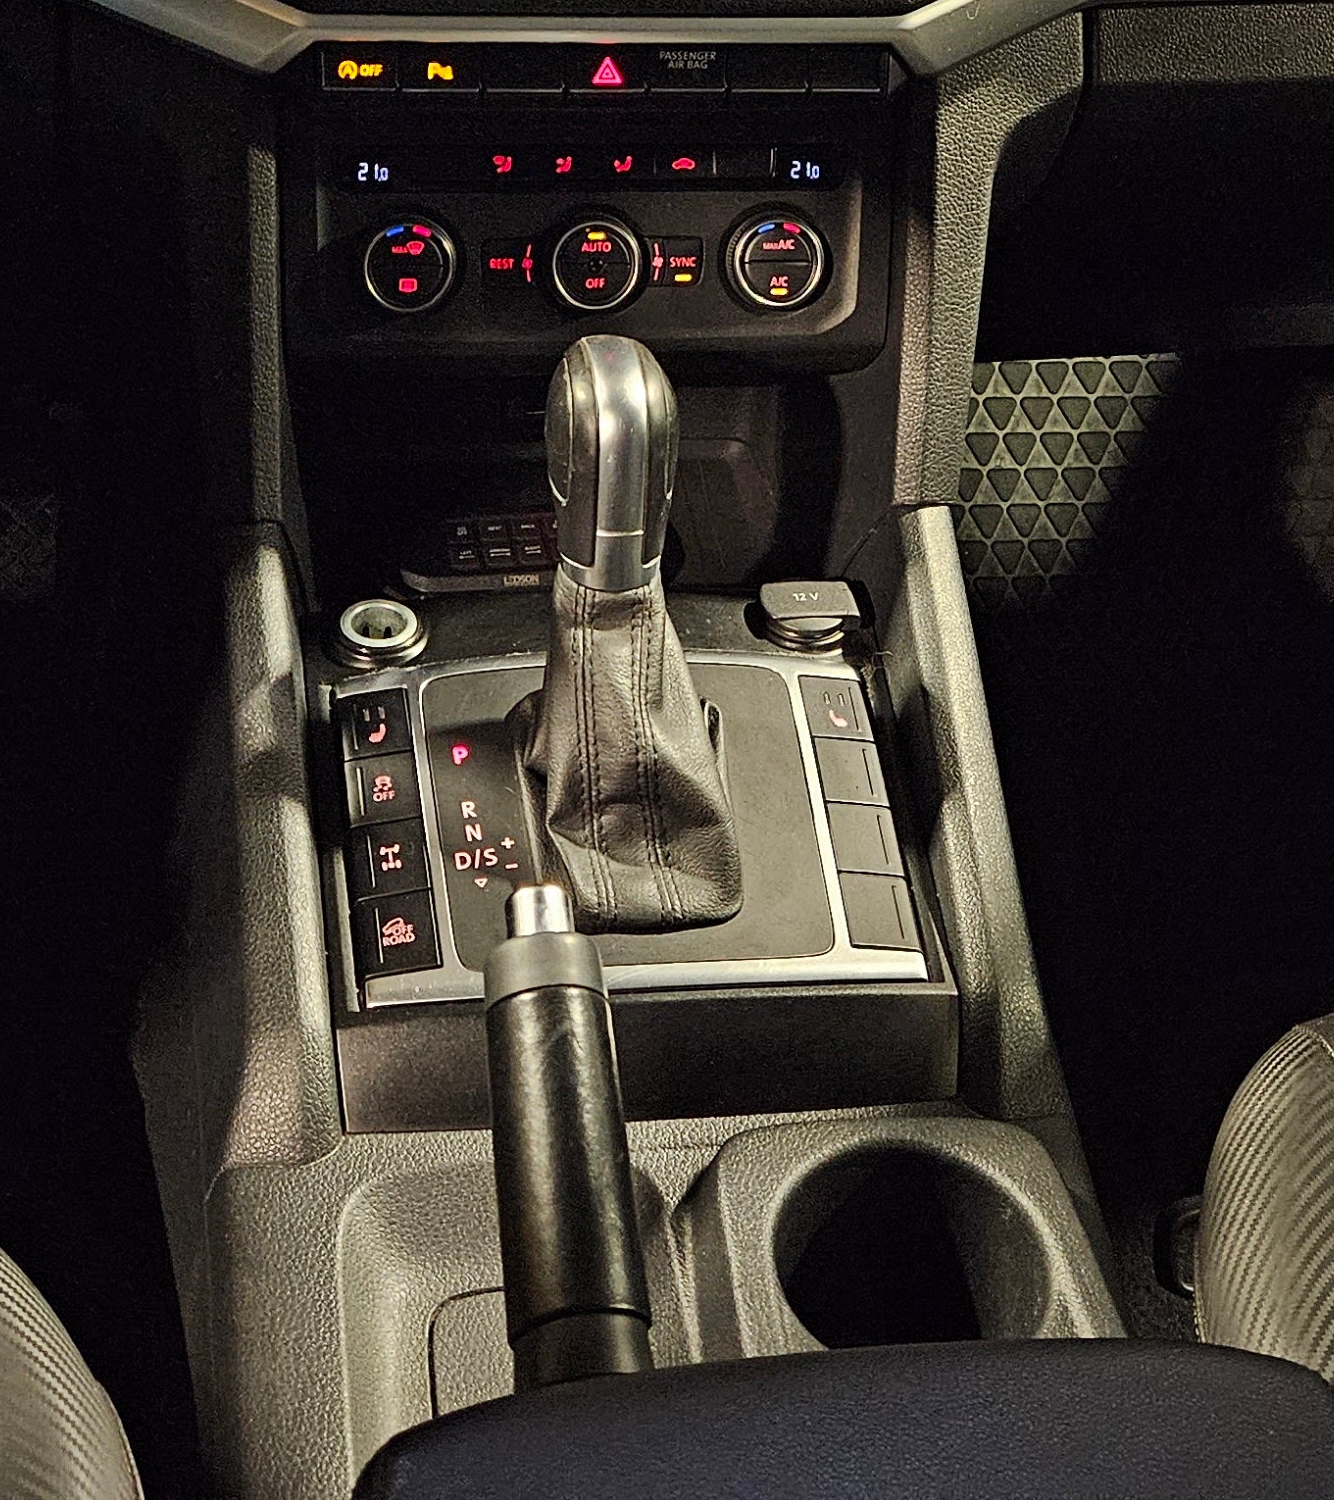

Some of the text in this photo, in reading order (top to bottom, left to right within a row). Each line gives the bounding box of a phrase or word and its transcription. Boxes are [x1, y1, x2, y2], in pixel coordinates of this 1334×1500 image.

[659, 51, 717, 61] PASSENGER
[359, 64, 383, 77] OFF
[668, 60, 708, 70] AIR BAG
[581, 241, 612, 253] AUTO
[489, 257, 515, 270] REST
[669, 256, 697, 268] SYNC
[585, 277, 606, 290] OFF
[769, 276, 789, 287] A/C
[792, 592, 819, 602] 12 V
[452, 745, 468, 764] P
[372, 790, 396, 802] OFF
[461, 800, 478, 819] R
[465, 823, 483, 842] N
[454, 848, 499, 870] D/S
[394, 924, 415, 935] OFF
[382, 933, 416, 947] ROAD
